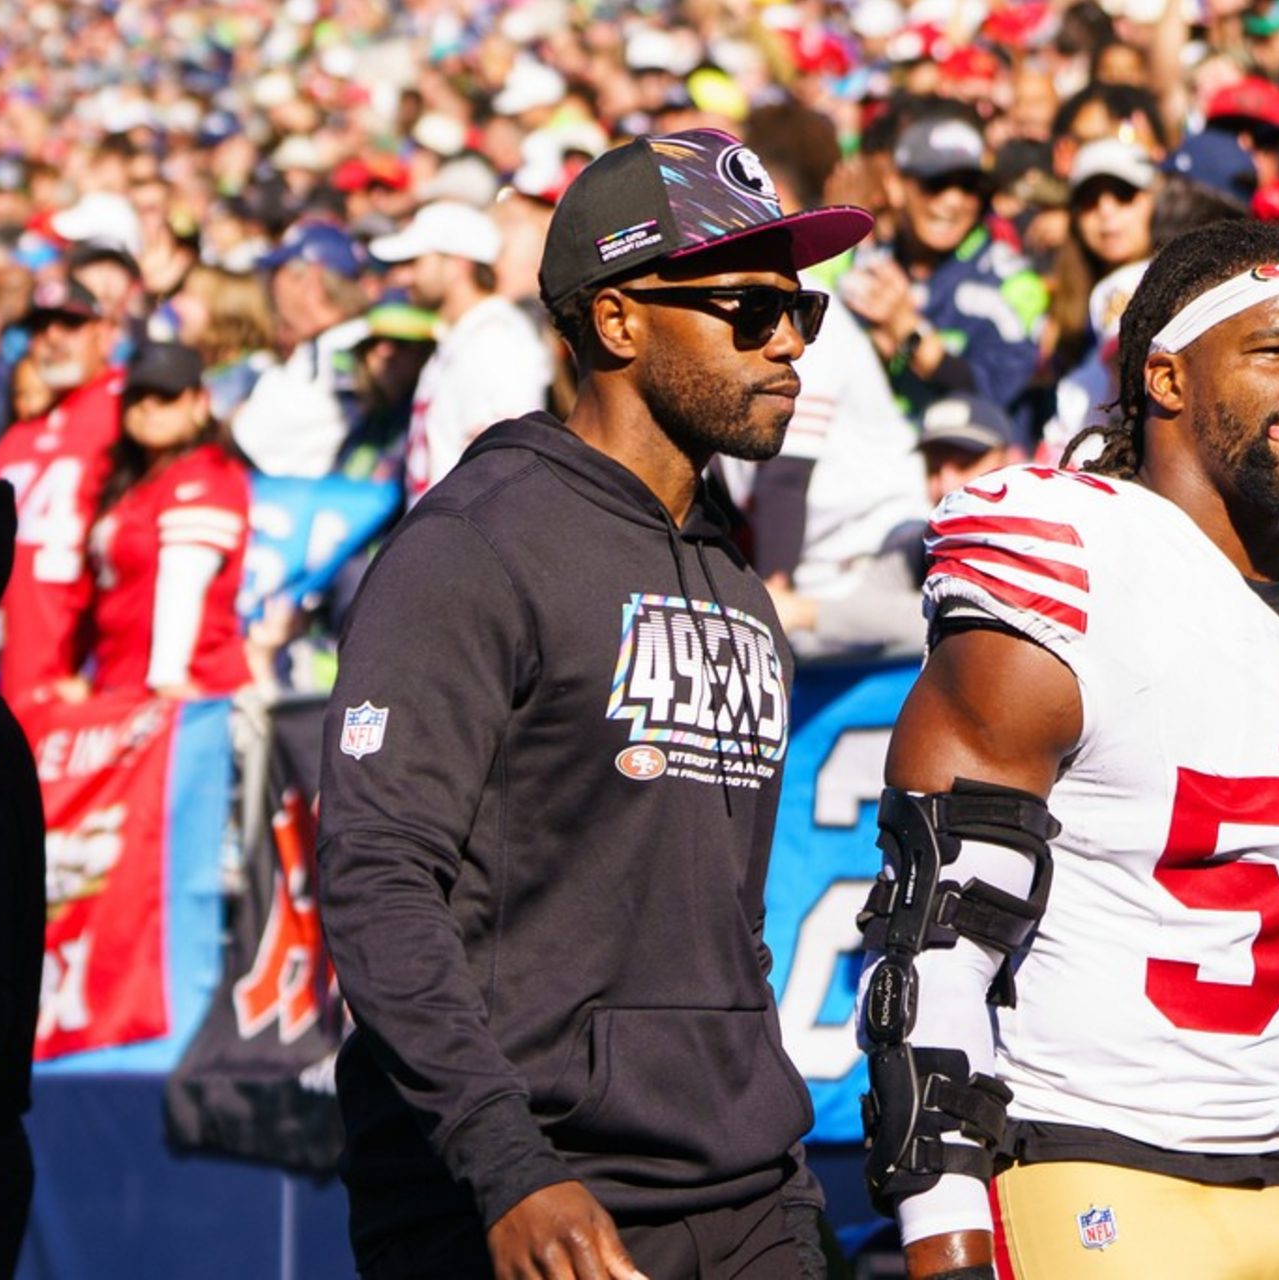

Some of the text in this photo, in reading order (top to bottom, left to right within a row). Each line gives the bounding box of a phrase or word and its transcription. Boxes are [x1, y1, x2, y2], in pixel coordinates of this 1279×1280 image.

[628, 610, 784, 742] 49ERS
[345, 727, 374, 749] NFL
[1086, 1222, 1112, 1241] NFL
